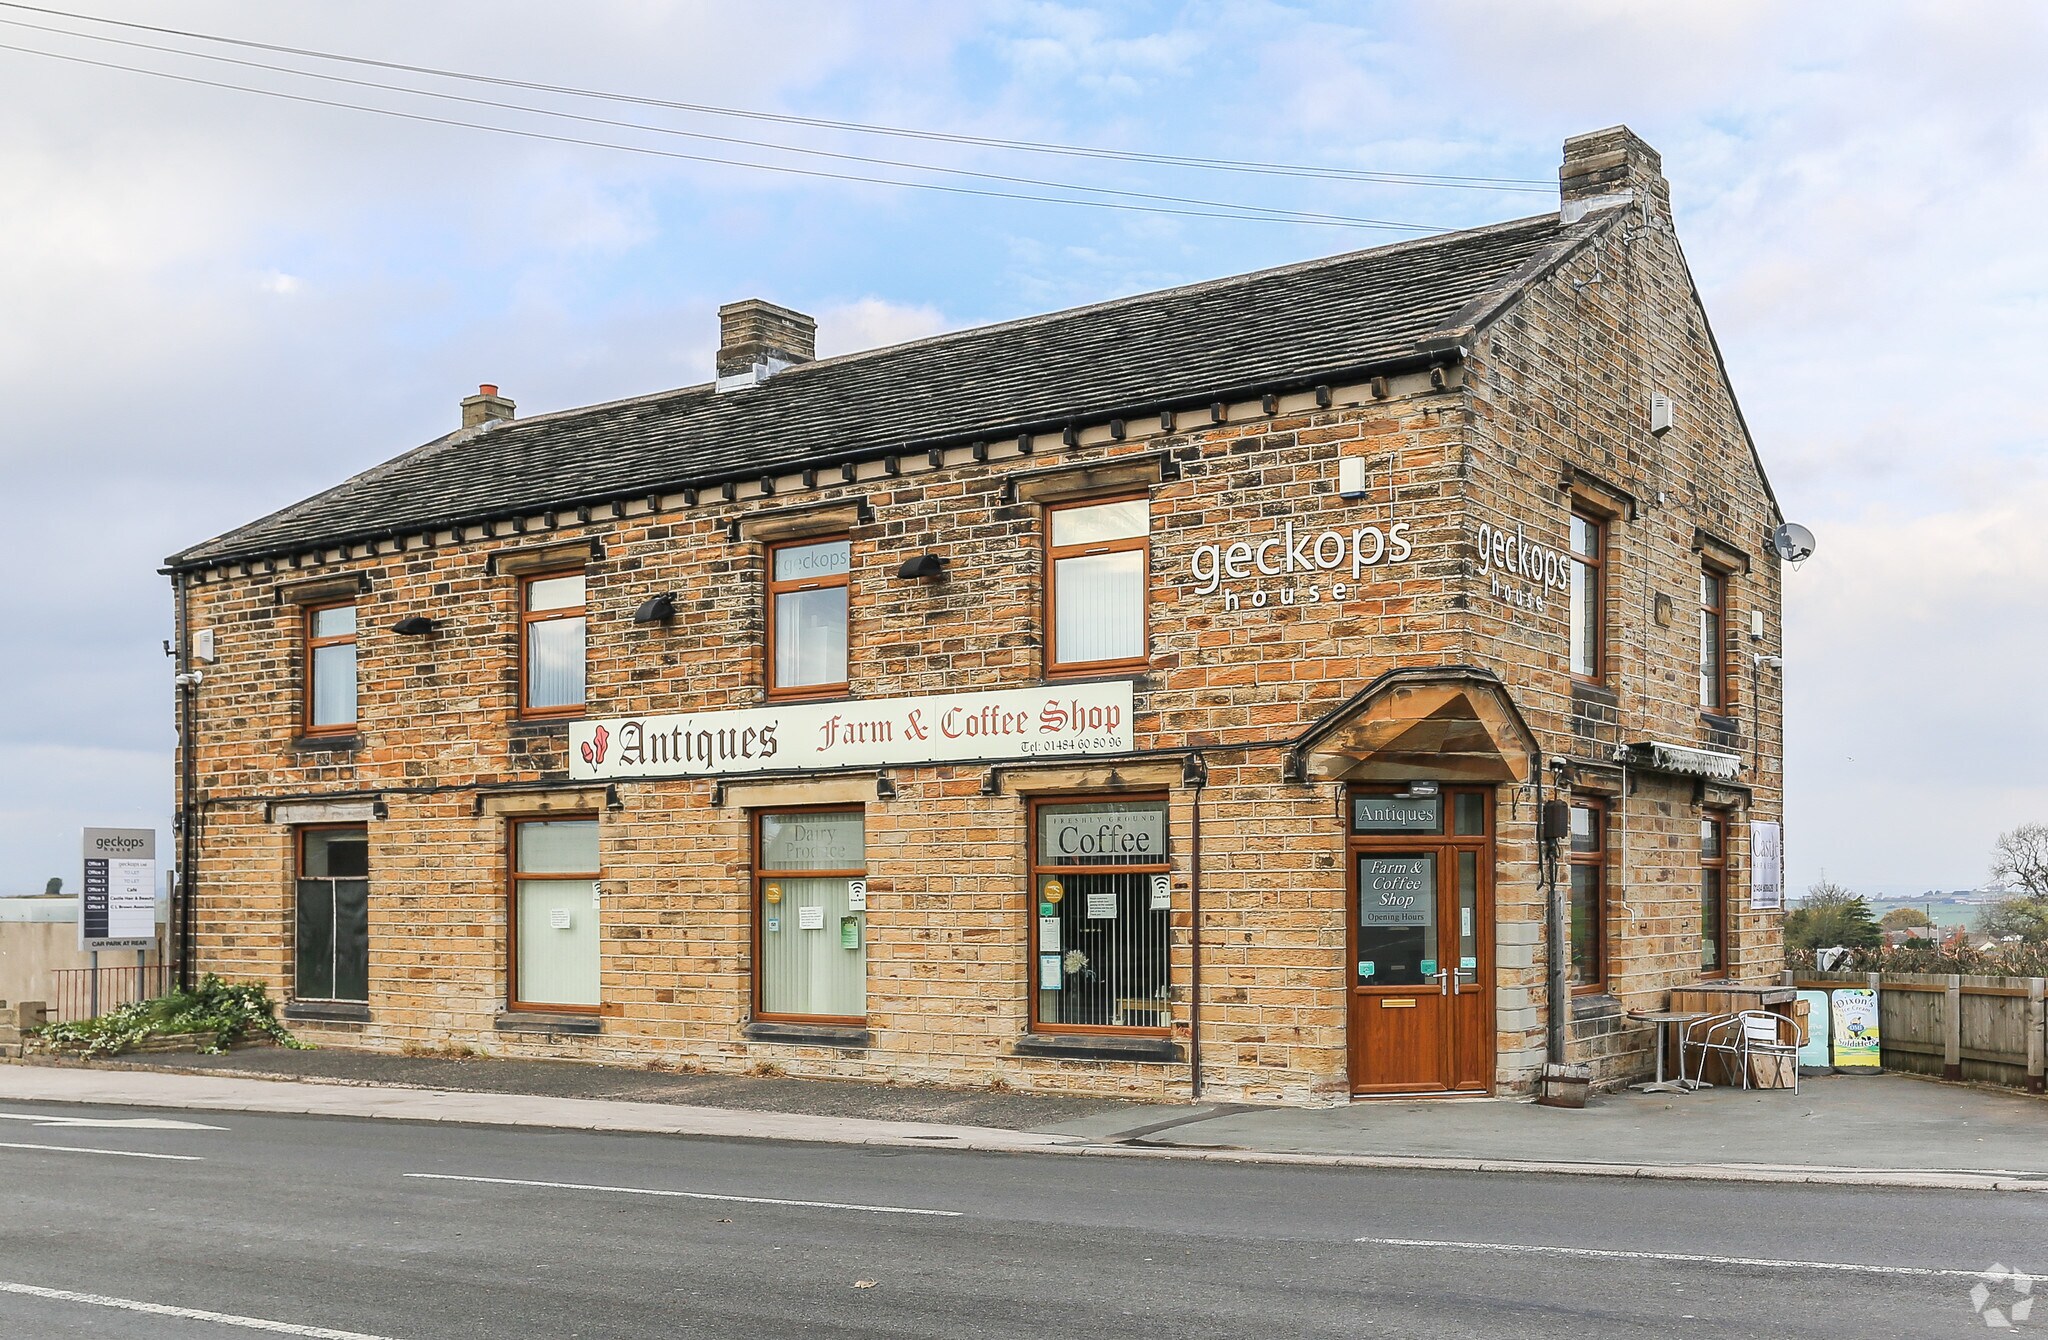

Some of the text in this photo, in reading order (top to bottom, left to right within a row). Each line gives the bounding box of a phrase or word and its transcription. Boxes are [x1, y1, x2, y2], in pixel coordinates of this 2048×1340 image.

[783, 550, 847, 576] geckops
[1191, 521, 1413, 595] geckops
[1478, 522, 1567, 598] geckops
[1225, 582, 1347, 611] house
[1491, 572, 1544, 612] house
[816, 698, 1121, 752] Farm & Coffee Shop
[618, 719, 779, 770] Antiques
[1021, 736, 1122, 752] Tel: 01484 60 80 96
[1053, 816, 1102, 824] FRESHLY
[1359, 804, 1434, 825] Antiques
[96, 836, 144, 849] geckops
[794, 825, 836, 845] Dairy
[1058, 824, 1150, 854] Coffee
[1753, 830, 1779, 860] Castle
[1370, 861, 1423, 874] Farm &
[1372, 876, 1421, 890] Coffee
[1379, 893, 1414, 909] Shop
[1367, 913, 1424, 922] Opening Hours
[1836, 997, 1875, 1008] Dixon's
